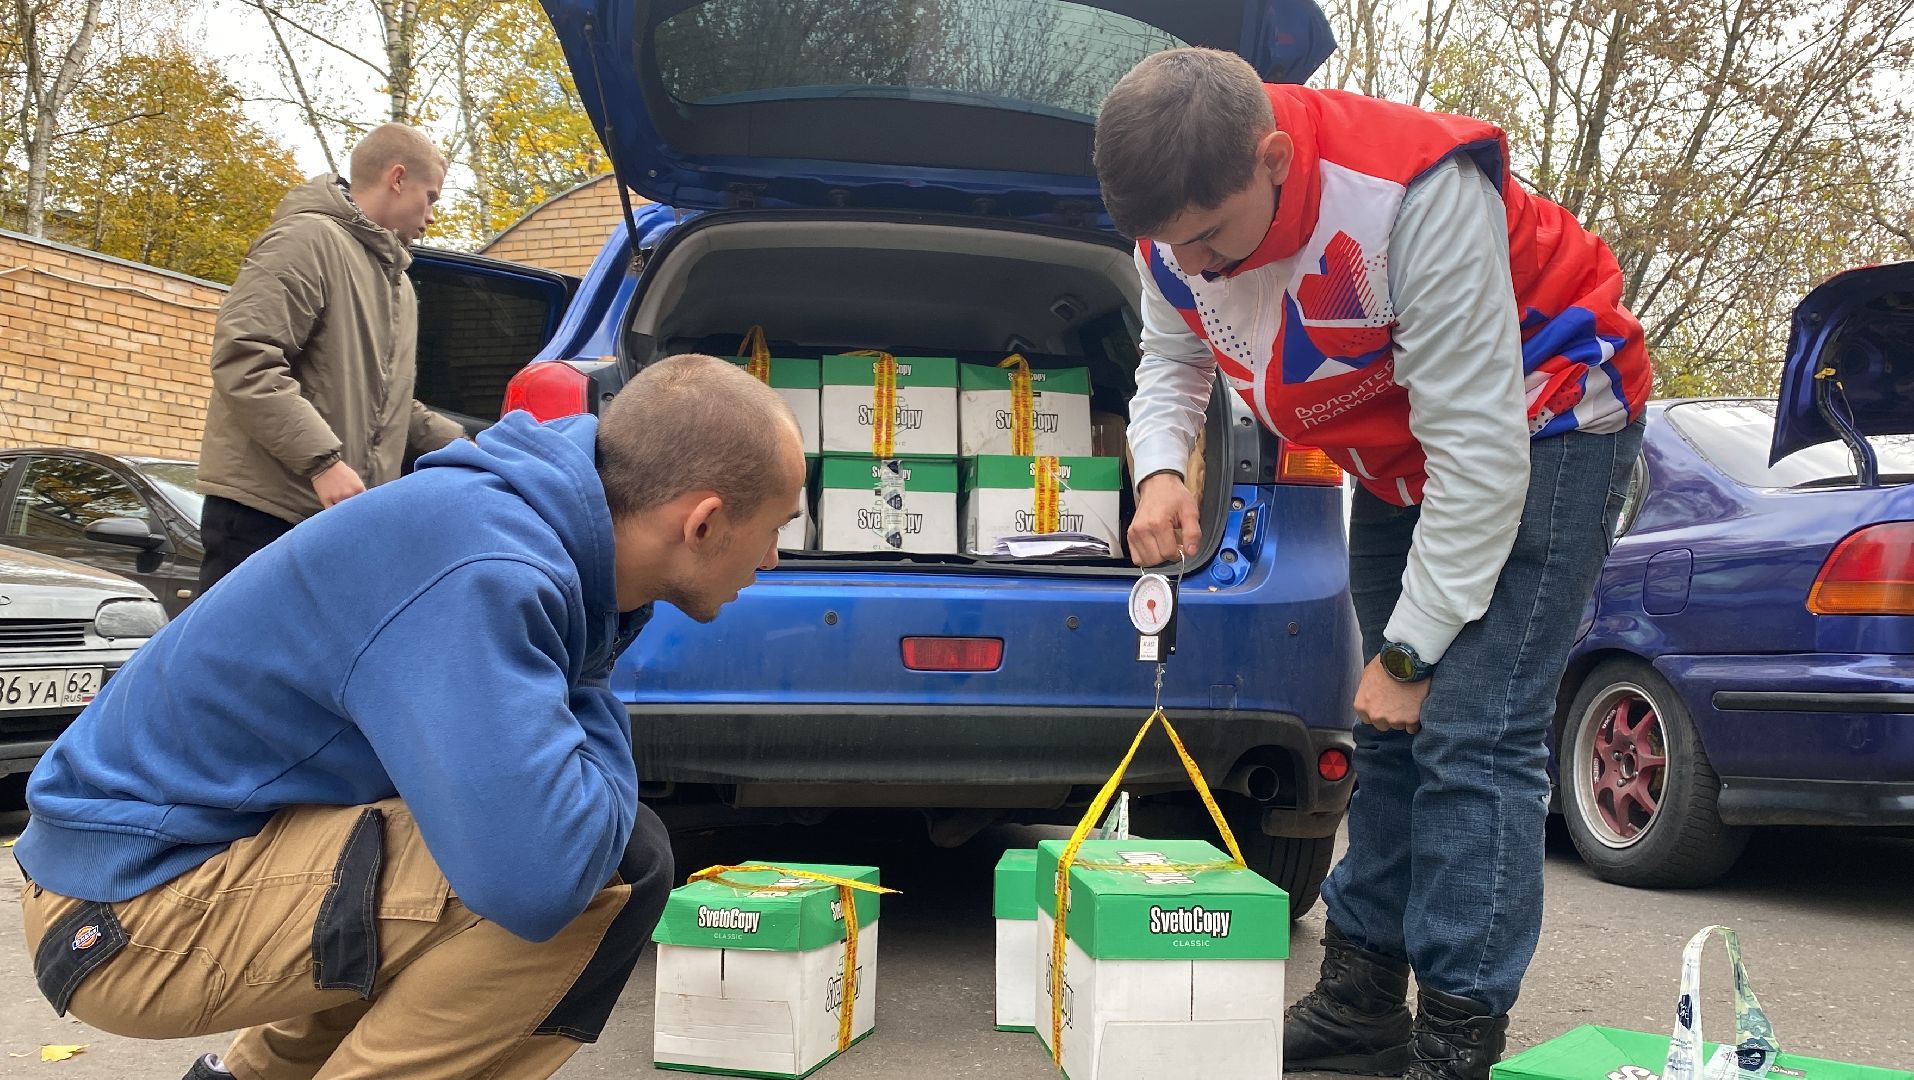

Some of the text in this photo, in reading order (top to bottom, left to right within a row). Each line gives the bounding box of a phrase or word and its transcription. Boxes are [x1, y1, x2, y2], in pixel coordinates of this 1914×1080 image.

[67, 672, 92, 693] 62
[64, 694, 82, 702] RUS
[698, 905, 761, 933] SvetoCopy
[1150, 904, 1232, 938] SvetoCopy
[713, 932, 743, 940] CLASSIC
[1172, 939, 1210, 947] CLASSIC
